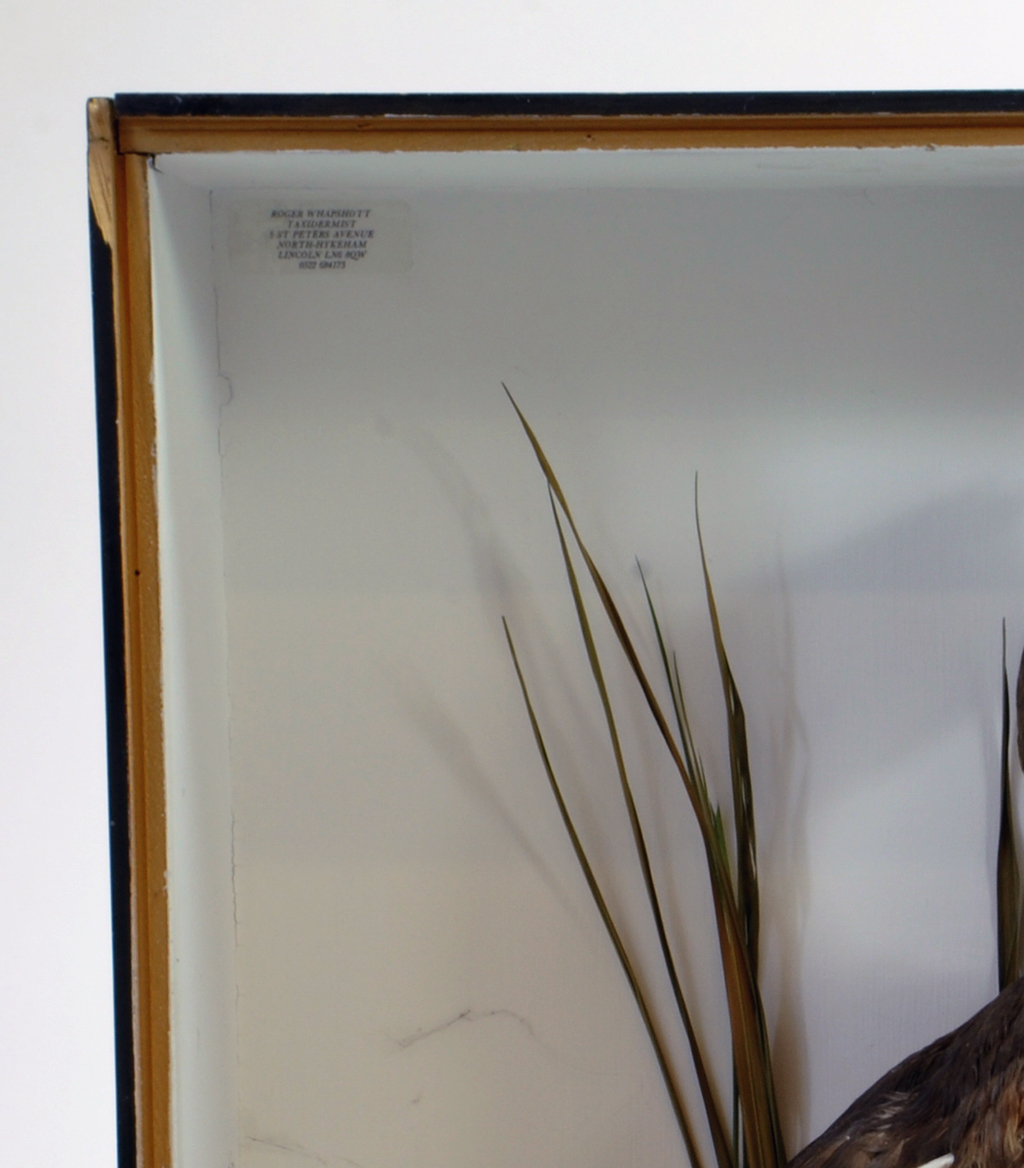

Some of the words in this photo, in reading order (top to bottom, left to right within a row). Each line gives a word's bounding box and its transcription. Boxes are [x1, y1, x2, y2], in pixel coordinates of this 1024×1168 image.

[271, 210, 303, 218] ROGER
[307, 209, 370, 218] WHAPSHOTT
[288, 220, 356, 228] TAXIDERMIST
[276, 231, 289, 239] ST
[293, 231, 331, 239] PETERS
[333, 231, 374, 239] AVENUE
[278, 251, 321, 260] LINCOLN
